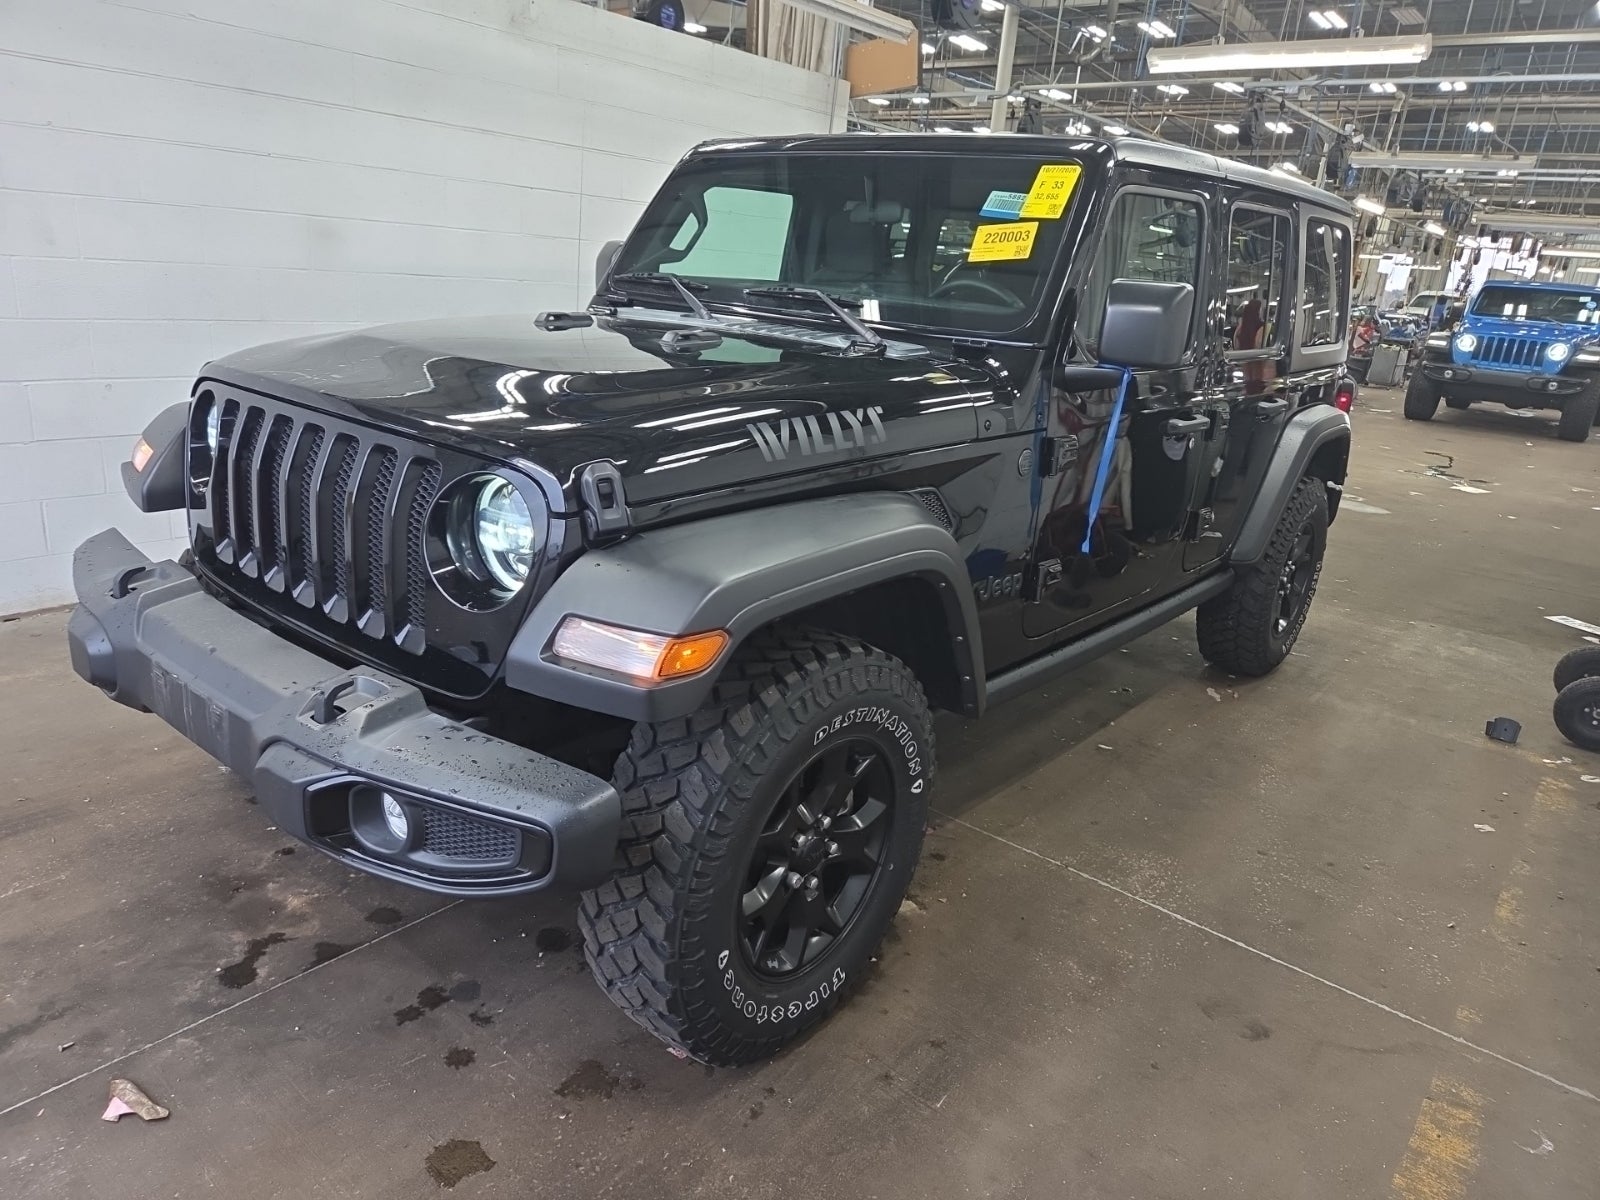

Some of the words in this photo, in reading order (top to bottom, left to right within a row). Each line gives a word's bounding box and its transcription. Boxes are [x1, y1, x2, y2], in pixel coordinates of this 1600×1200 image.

[1039, 181, 1047, 190] F
[1051, 180, 1065, 190] 33
[983, 230, 1031, 244] 220003
[746, 405, 886, 463] WILLYS
[973, 572, 1023, 601] Jeep
[813, 706, 923, 775] DESTINATION
